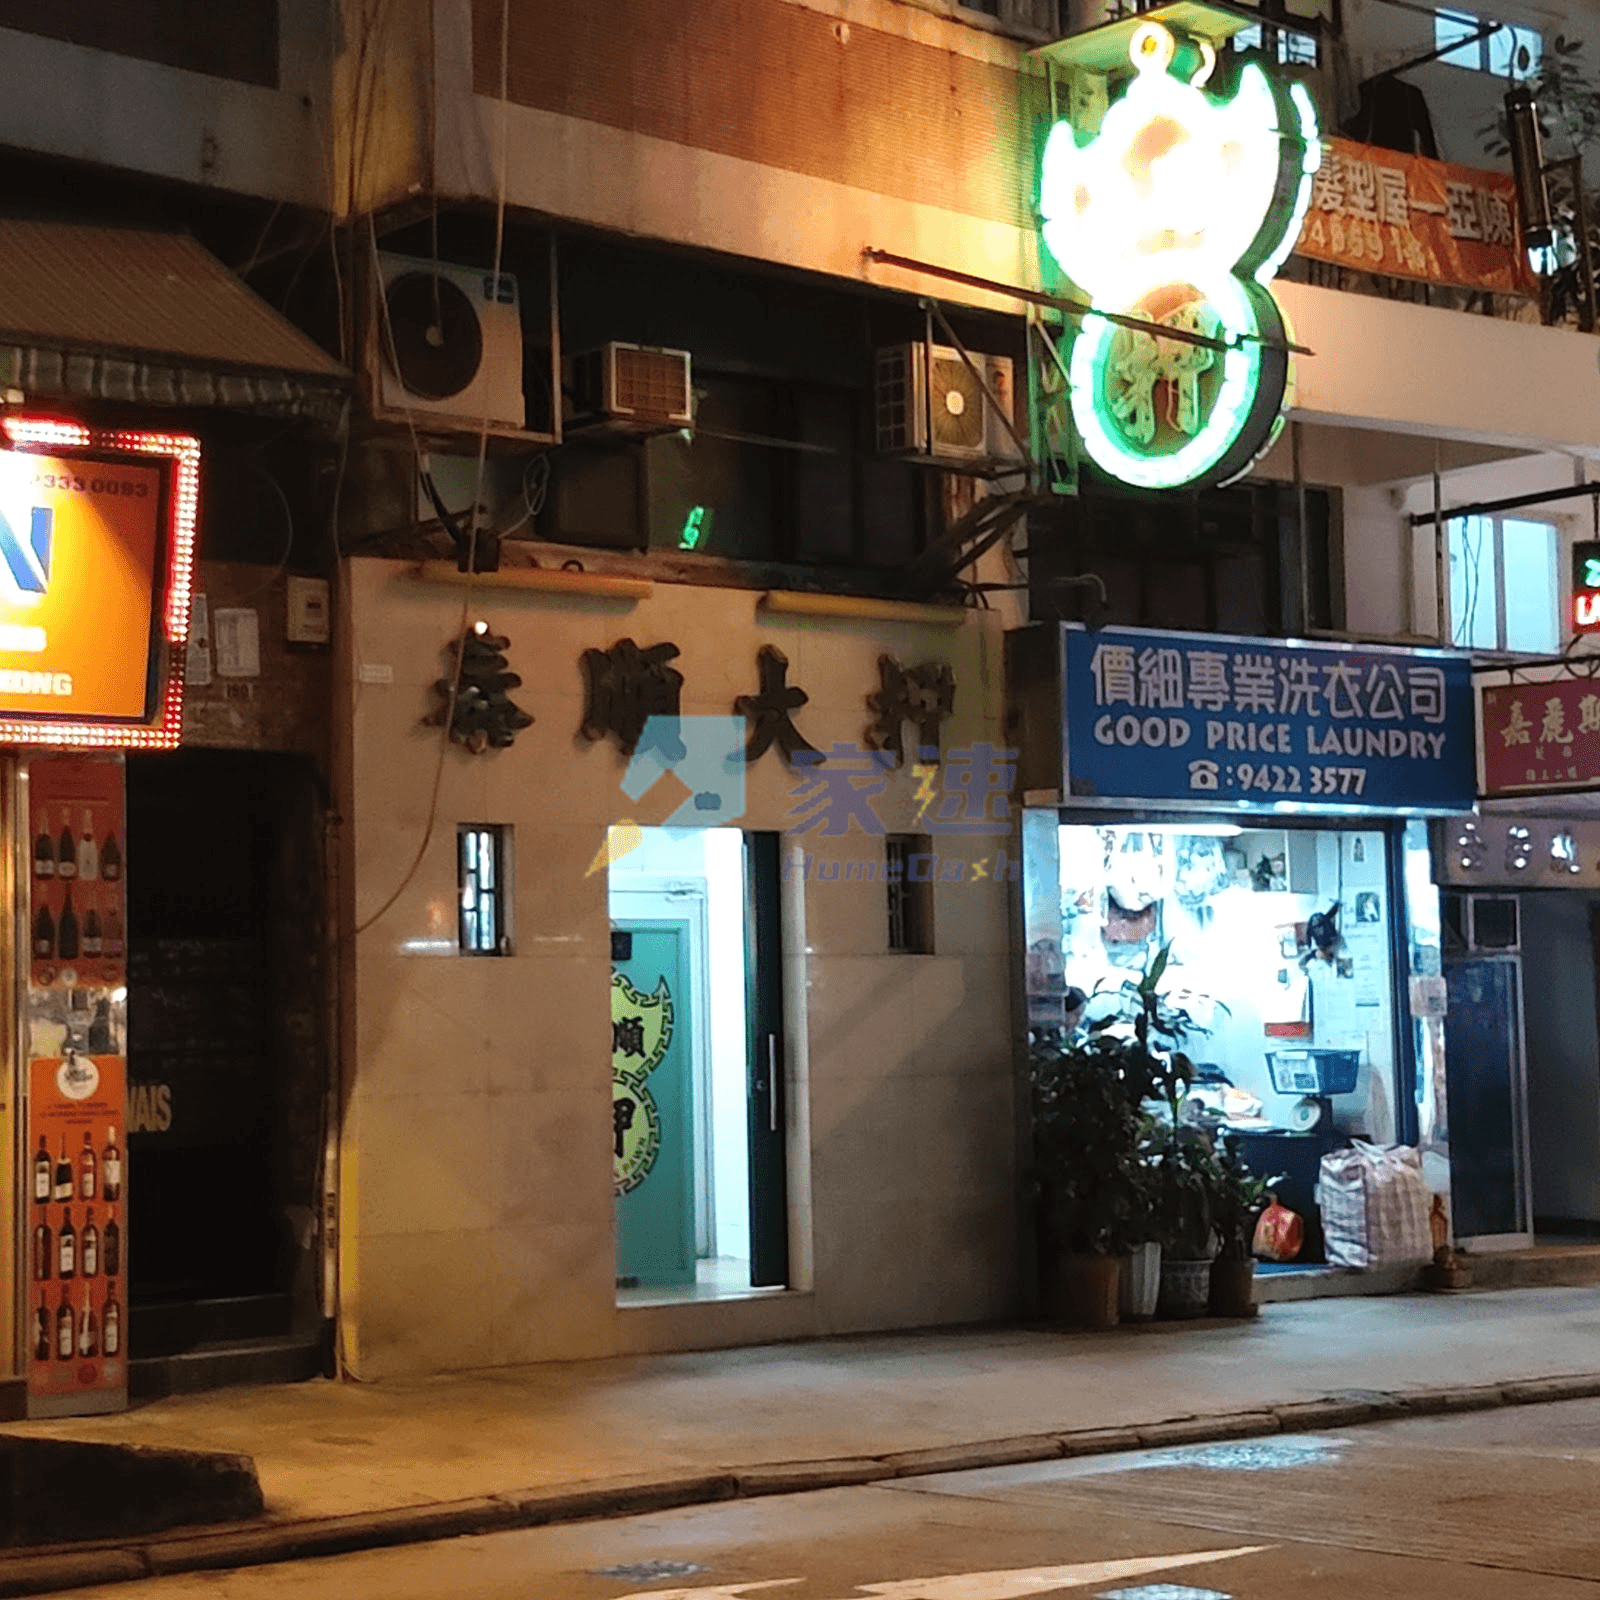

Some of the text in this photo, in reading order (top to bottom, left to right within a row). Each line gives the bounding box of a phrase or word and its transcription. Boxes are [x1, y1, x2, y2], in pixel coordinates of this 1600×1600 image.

[0, 669, 73, 696] ONG
[1090, 644, 1446, 724] 價細專業洗衣公司
[1094, 714, 1447, 760] GOOD PRICE LAUNDRY
[1309, 765, 1367, 796] 3577
